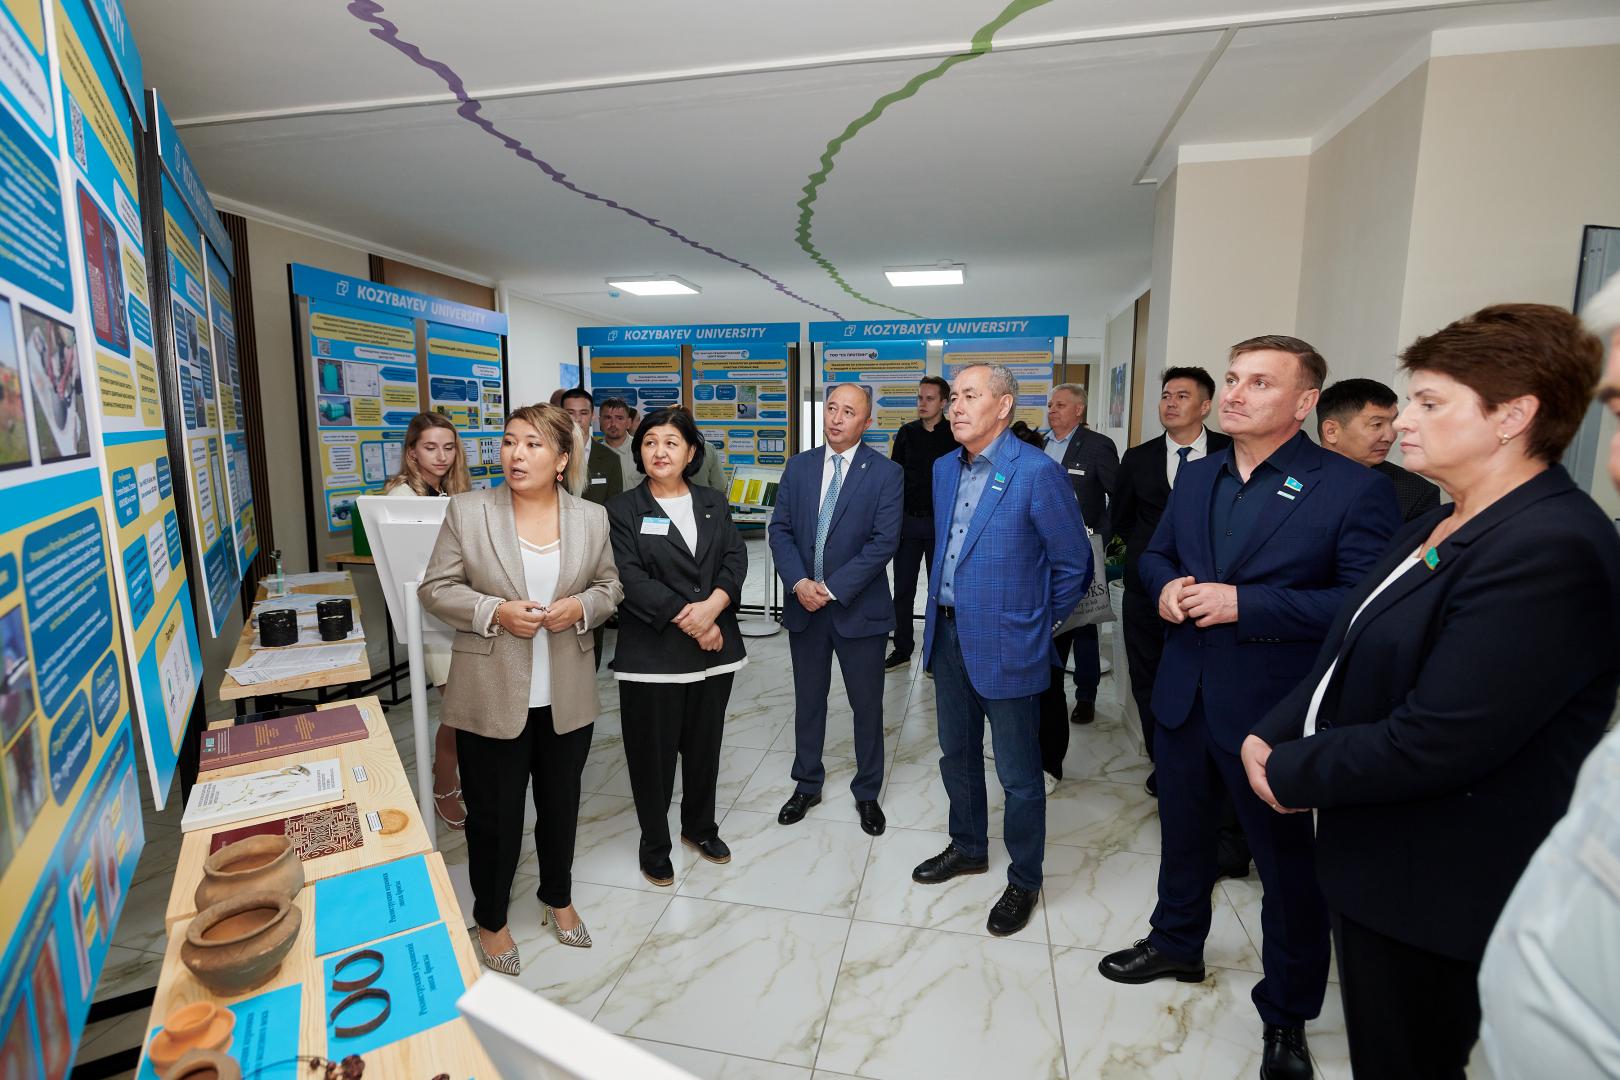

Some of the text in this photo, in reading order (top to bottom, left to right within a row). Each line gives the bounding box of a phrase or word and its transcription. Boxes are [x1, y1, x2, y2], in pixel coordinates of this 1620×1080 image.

[357, 284, 488, 325] KOZYBAYEV UNIVERSITY
[624, 327, 767, 341] KOZYBAYEV UNIVERSITY
[863, 320, 1030, 336] KOZYBAYEV UNIVERSITY
